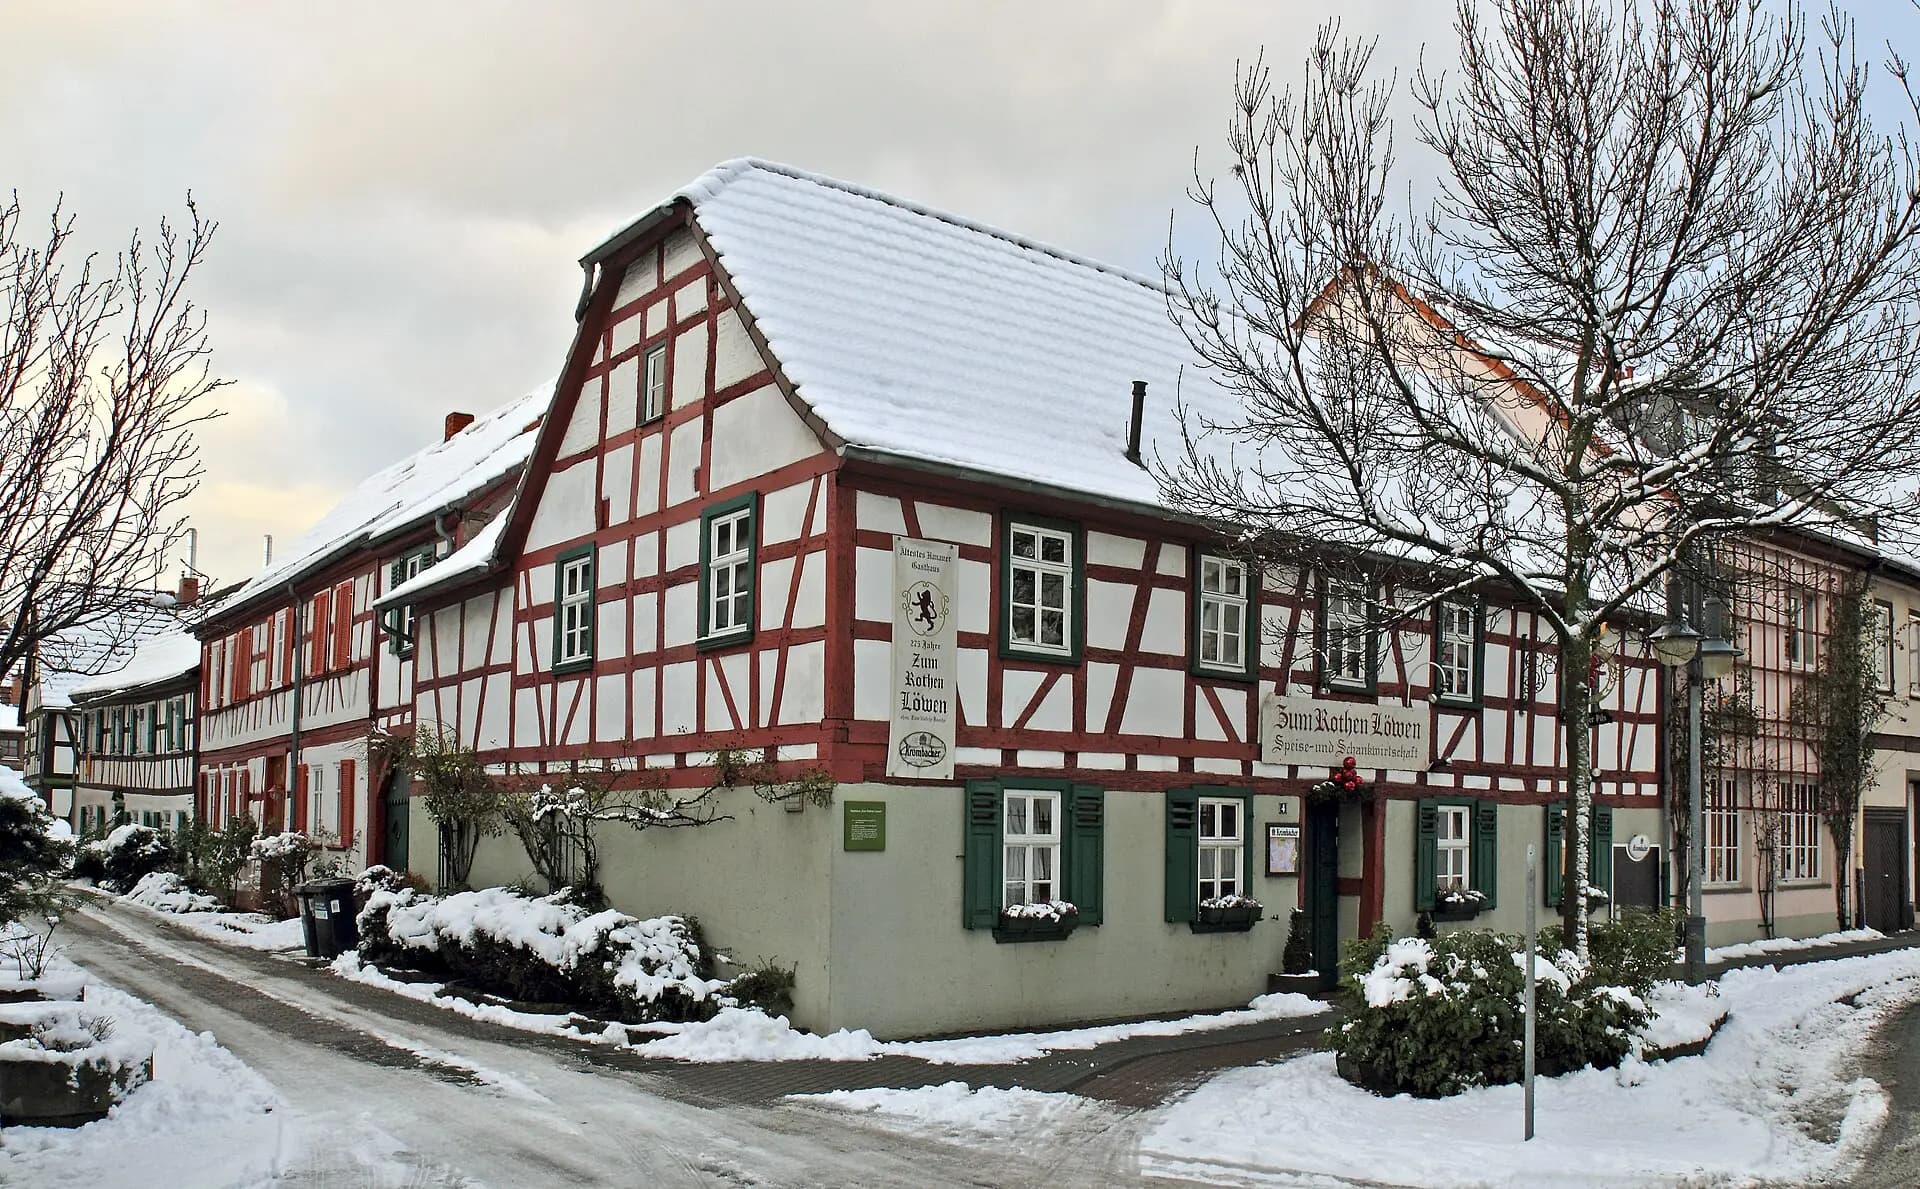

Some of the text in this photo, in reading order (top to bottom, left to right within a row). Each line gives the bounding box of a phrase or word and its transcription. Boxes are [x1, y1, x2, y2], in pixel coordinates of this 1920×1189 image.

[921, 640, 941, 651] Jahre
[912, 653, 938, 669] Zum
[905, 671, 944, 689] Rothen
[900, 691, 947, 714] Löwen
[1273, 704, 1421, 739] Zum Rothen Löwen
[904, 745, 941, 758] Krombacher
[1335, 738, 1418, 761] Schankwirtschaft
